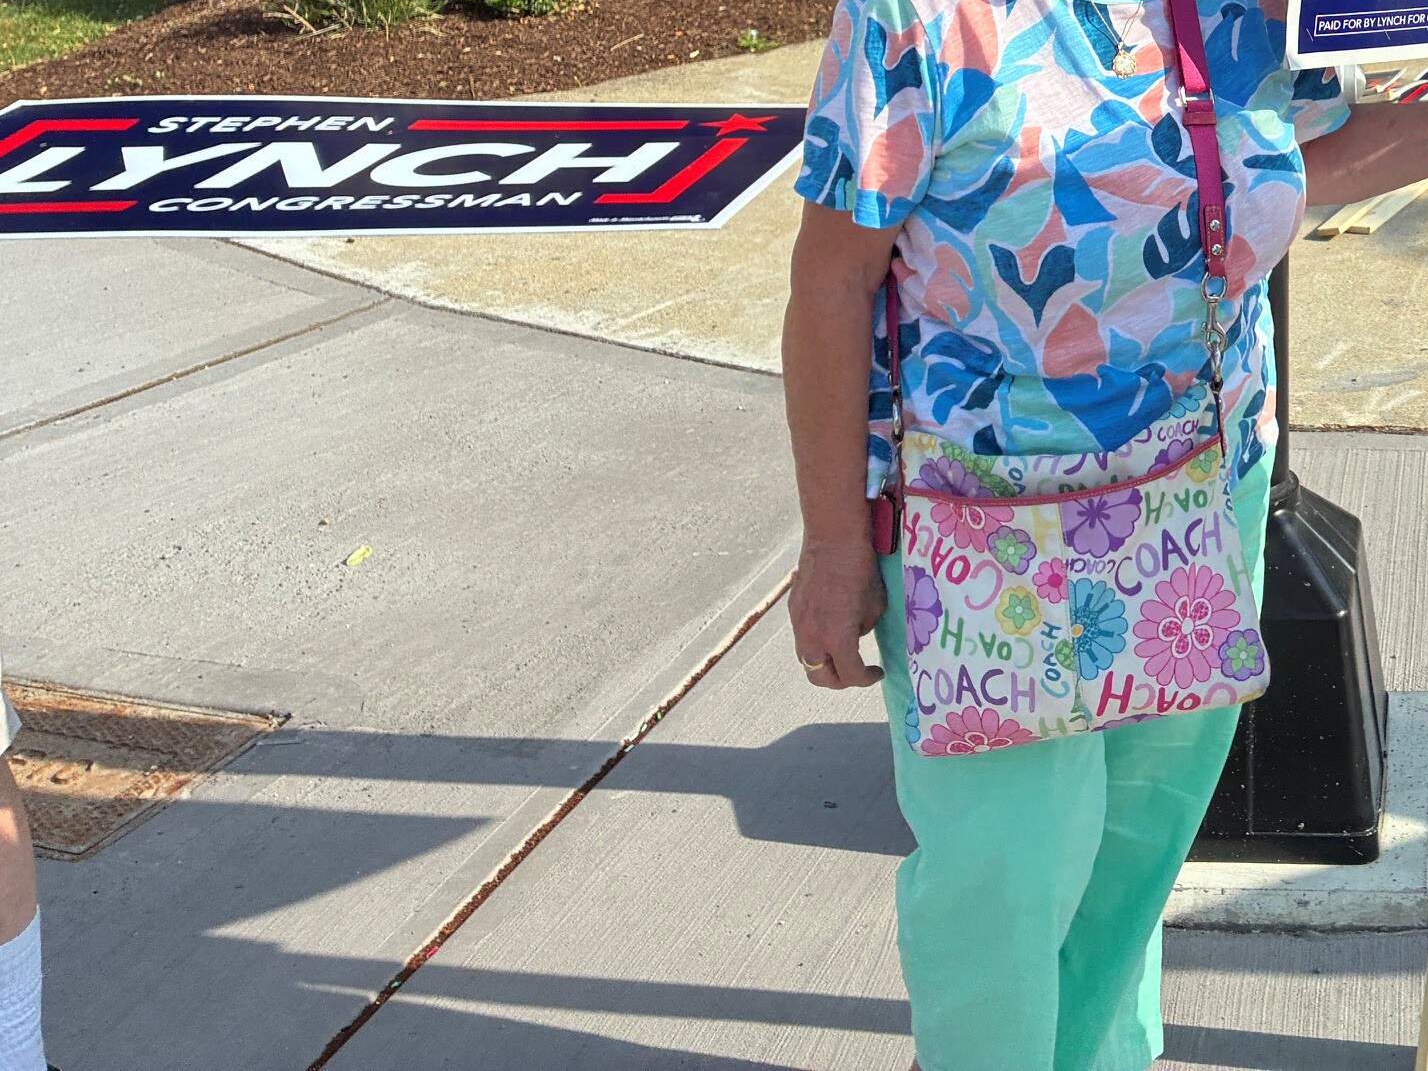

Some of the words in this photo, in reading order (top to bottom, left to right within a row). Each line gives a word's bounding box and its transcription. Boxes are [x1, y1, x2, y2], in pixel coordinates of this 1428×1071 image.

[1318, 20, 1341, 31] PAID
[1343, 18, 1362, 29] FOR
[1363, 17, 1376, 27] BY
[1377, 15, 1406, 27] LYNCH
[1407, 13, 1426, 24] FOR
[147, 116, 394, 134] STEPHEN
[0, 141, 681, 193] LYNCH
[148, 192, 582, 213] CONGRESSMAN
[1157, 418, 1199, 442] COACH
[1114, 511, 1223, 597] COACH
[940, 608, 1034, 669] COACH
[1040, 621, 1071, 699] COACH
[917, 664, 1036, 715] COACH
[1096, 671, 1238, 717] COACH
